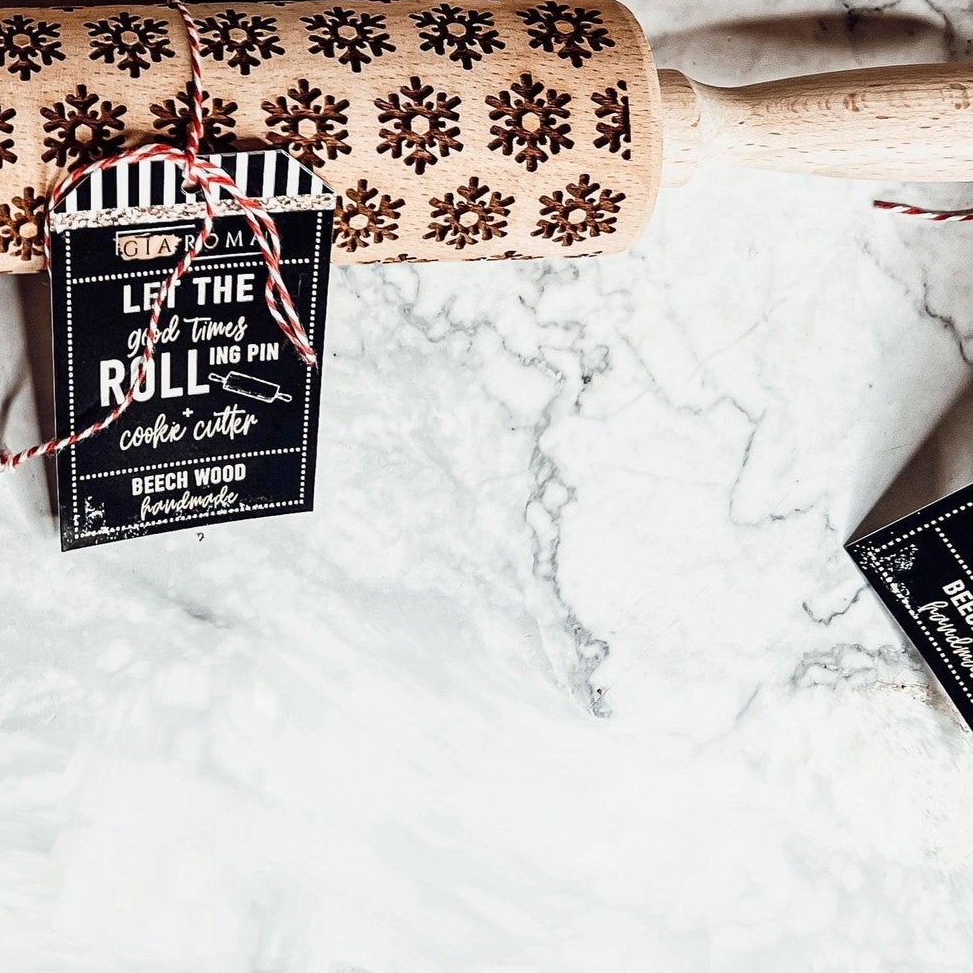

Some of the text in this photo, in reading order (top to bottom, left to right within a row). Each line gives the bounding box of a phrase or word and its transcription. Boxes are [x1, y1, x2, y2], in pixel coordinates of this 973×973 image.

[192, 273, 255, 306] THE
[183, 316, 248, 343] times
[99, 342, 279, 407] ROLL ING PIN
[119, 403, 259, 451] cookie cutter
[131, 463, 246, 496] BEECH WOOD
[141, 485, 239, 521] handmade
